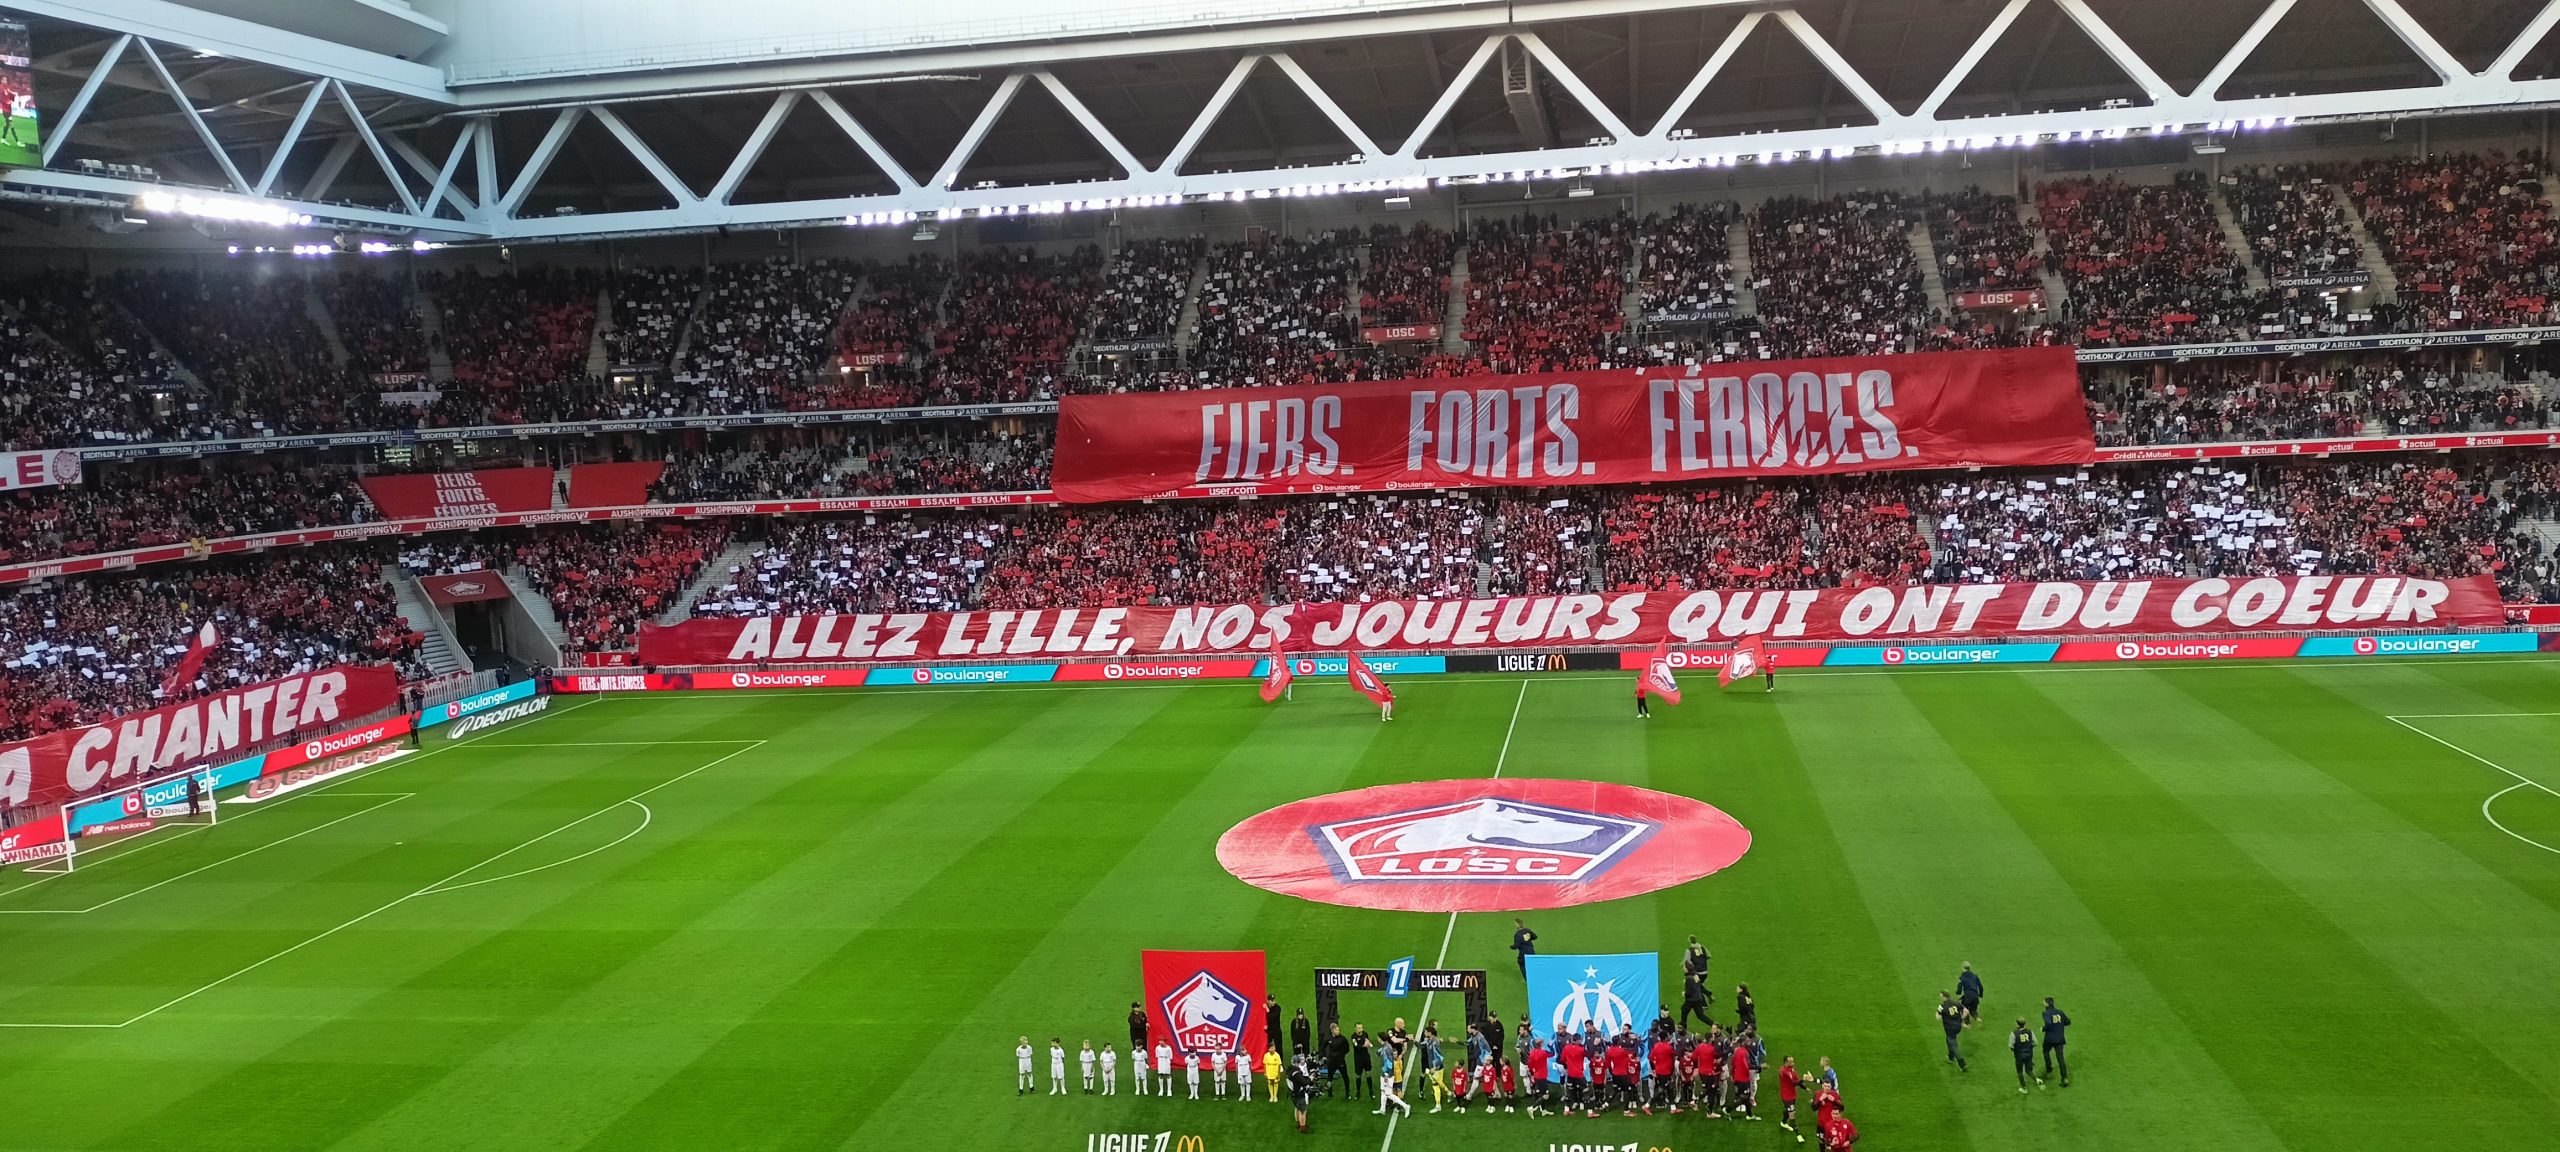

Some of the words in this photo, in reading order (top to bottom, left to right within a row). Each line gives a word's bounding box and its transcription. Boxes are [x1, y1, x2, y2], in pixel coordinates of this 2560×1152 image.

[2337, 275, 2369, 284] ARENA
[1980, 293, 2013, 304] LOSC
[1648, 314, 1688, 322] DECTHLON
[1701, 311, 1730, 320] ARENA
[1386, 327, 1415, 338] LOSC
[2485, 332, 2529, 341] DECATHLON
[1141, 342, 1166, 350] ARENA
[2275, 343, 2318, 351] DECATHLON
[2331, 341, 2362, 349] ARENA
[2378, 338, 2422, 346] DECATHLON
[2436, 335, 2467, 343] ARENA
[2126, 351, 2156, 359] ARENA
[2173, 348, 2215, 356] DECATHLON
[2228, 346, 2258, 354] ARENA
[856, 355, 884, 366] LOSC
[922, 409, 955, 418] DECATHLON
[966, 407, 989, 416] ARENA
[1002, 405, 1036, 414] DECATHLON
[764, 416, 796, 424] DECATHLON
[807, 414, 830, 422] ARENA
[842, 412, 875, 421] DECATHLON
[886, 411, 909, 419] ARENA
[602, 423, 637, 431] DECATHLON
[648, 421, 672, 429] ARENA
[685, 419, 718, 427] DECATHLON
[728, 417, 751, 425] ARENA
[1195, 395, 1355, 483] FIERS.
[1407, 383, 1596, 478] FORTS.
[1649, 369, 1919, 472] FÉROCES.
[421, 430, 459, 440] DECATHLON
[471, 429, 498, 438] ARENA
[513, 426, 550, 435] DECATHLON
[562, 425, 588, 433] ARENA
[241, 441, 277, 450] DECATHLON
[289, 439, 315, 448] ARENA
[329, 436, 367, 445] DECATHLON
[2409, 439, 2436, 448] actual
[2476, 436, 2504, 445] actual
[159, 446, 192, 455] DECATHLON
[202, 443, 227, 452] ARENA
[2251, 446, 2277, 455] actual
[2327, 442, 2354, 451] actual
[83, 451, 116, 460] DECATHLON
[125, 448, 147, 456] ARENA
[2113, 452, 2137, 460] Crédit
[2145, 450, 2172, 459] Mutuel
[433, 472, 482, 488] FIERS.
[1397, 481, 1436, 489] boulanger
[1209, 485, 1257, 496] user.com
[1324, 484, 1362, 492] boulanger
[436, 487, 490, 504] FORTS.
[971, 495, 1010, 504] ESSALMI
[820, 501, 859, 510] ESSALMI
[870, 500, 909, 508] ESSALMI
[920, 498, 959, 506] ESSALMI
[728, 613, 928, 661] ALLEZ
[936, 607, 1133, 656] LILLE,
[1158, 603, 1296, 651] NOS
[1312, 590, 1647, 647] JOUEURS
[1667, 589, 1819, 644] QUI
[1839, 582, 2007, 635] ONT
[2016, 580, 2153, 631] DU
[2170, 576, 2450, 629] COEUR
[2143, 642, 2238, 658] boulanger
[2380, 638, 2480, 653] boulanger
[1908, 648, 2000, 663] boulanger
[1319, 660, 1399, 675] bounger
[1497, 655, 1535, 672] LIGUE
[934, 668, 1009, 683] boulanger
[1126, 664, 1204, 678] boulanger
[753, 673, 826, 686] boulanger
[461, 690, 510, 712] boulanger
[472, 695, 550, 731] DECATHLON
[66, 671, 347, 792] CHANTER
[324, 727, 384, 752] boulanger
[283, 740, 404, 785] boulanger
[104, 824, 120, 832] new
[121, 820, 151, 830] balance
[1378, 855, 1560, 875] LOSC
[1321, 973, 1351, 987] LIGUE
[1420, 974, 1452, 988] LIGUE
[1185, 1033, 1229, 1047] LOSC
[1087, 1133, 1149, 1152] LIGUE
